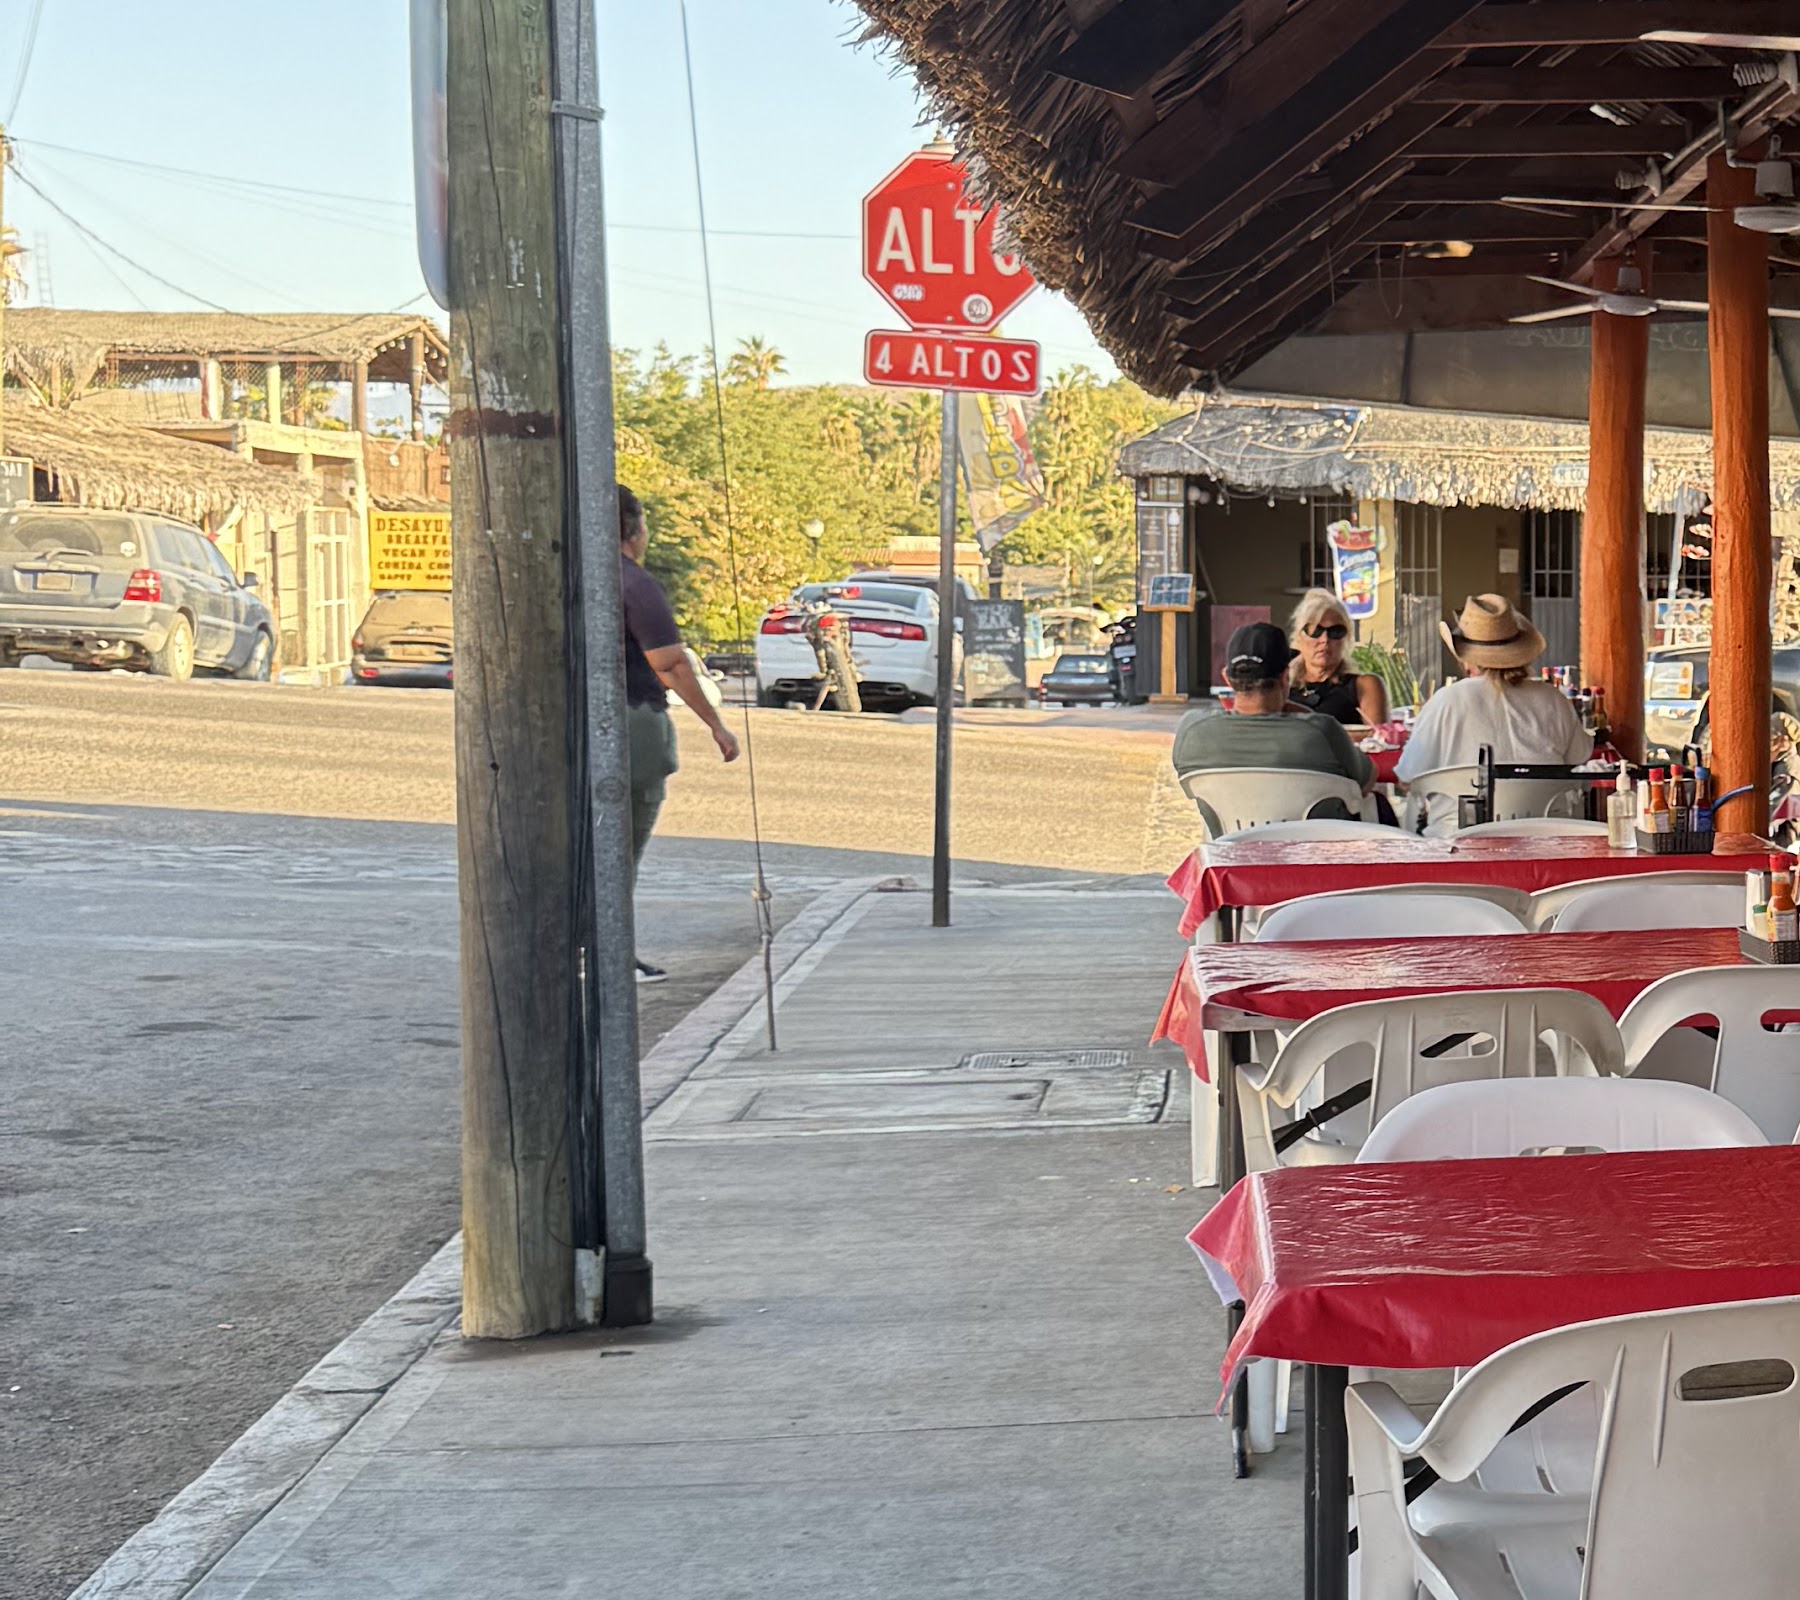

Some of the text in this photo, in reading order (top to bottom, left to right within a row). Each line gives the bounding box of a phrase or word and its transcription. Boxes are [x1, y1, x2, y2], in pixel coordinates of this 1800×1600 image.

[875, 342, 1032, 382] 4 ALTOS
[375, 518, 451, 533] DESAYU
